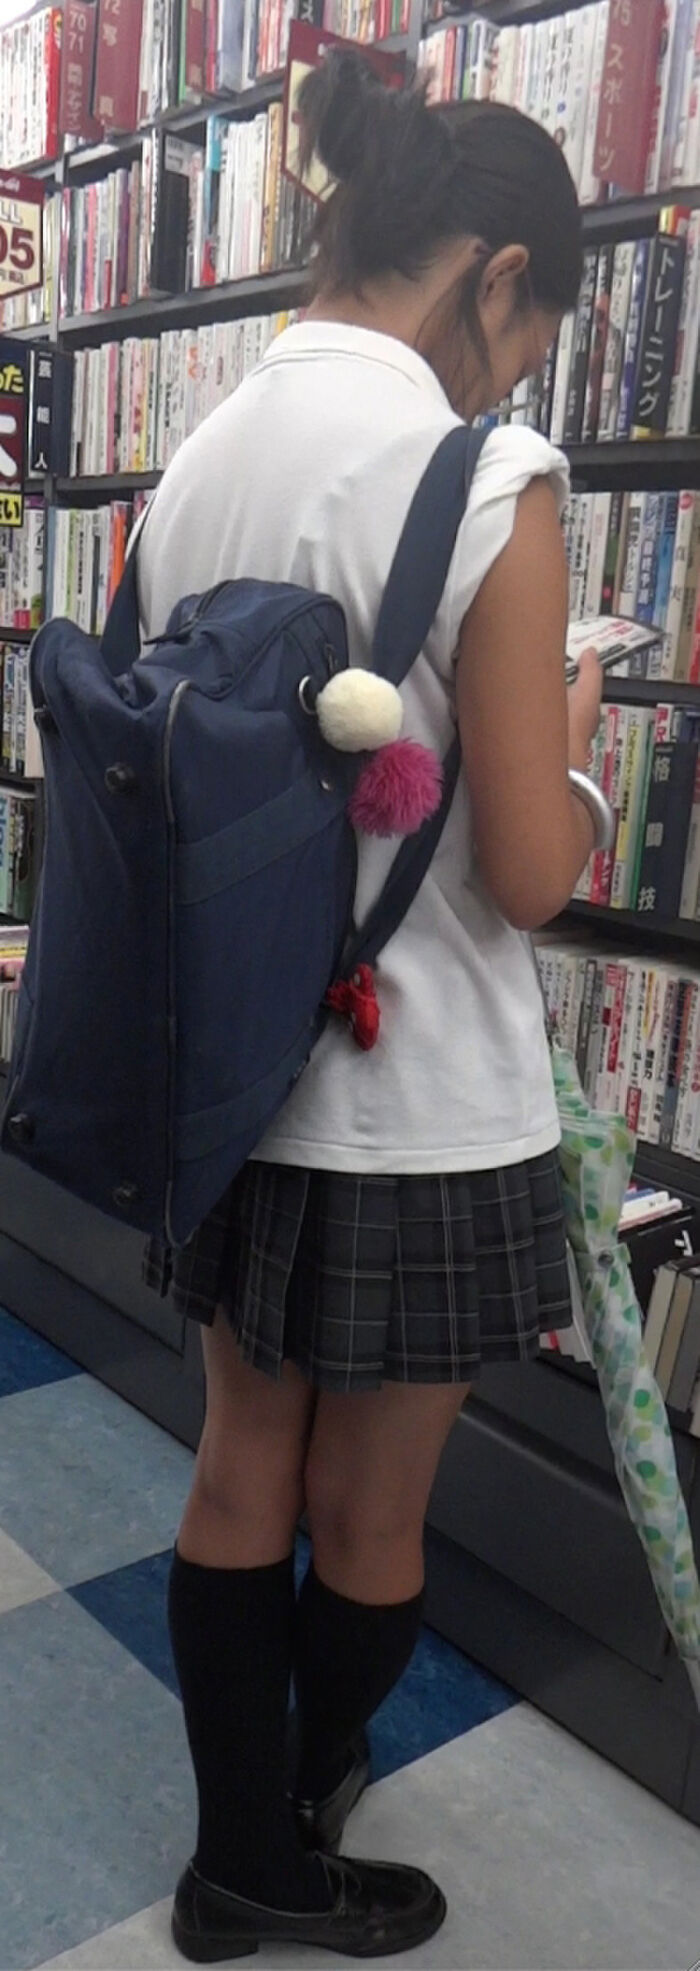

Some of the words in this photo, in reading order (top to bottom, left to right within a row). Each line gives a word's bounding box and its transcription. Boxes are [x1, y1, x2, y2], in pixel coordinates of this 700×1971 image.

[69, 32, 84, 53] 71
[70, 10, 86, 32] 70
[599, 42, 625, 171] スポーツ
[638, 248, 675, 416] トレーニング
[636, 755, 671, 911] 格闘技
